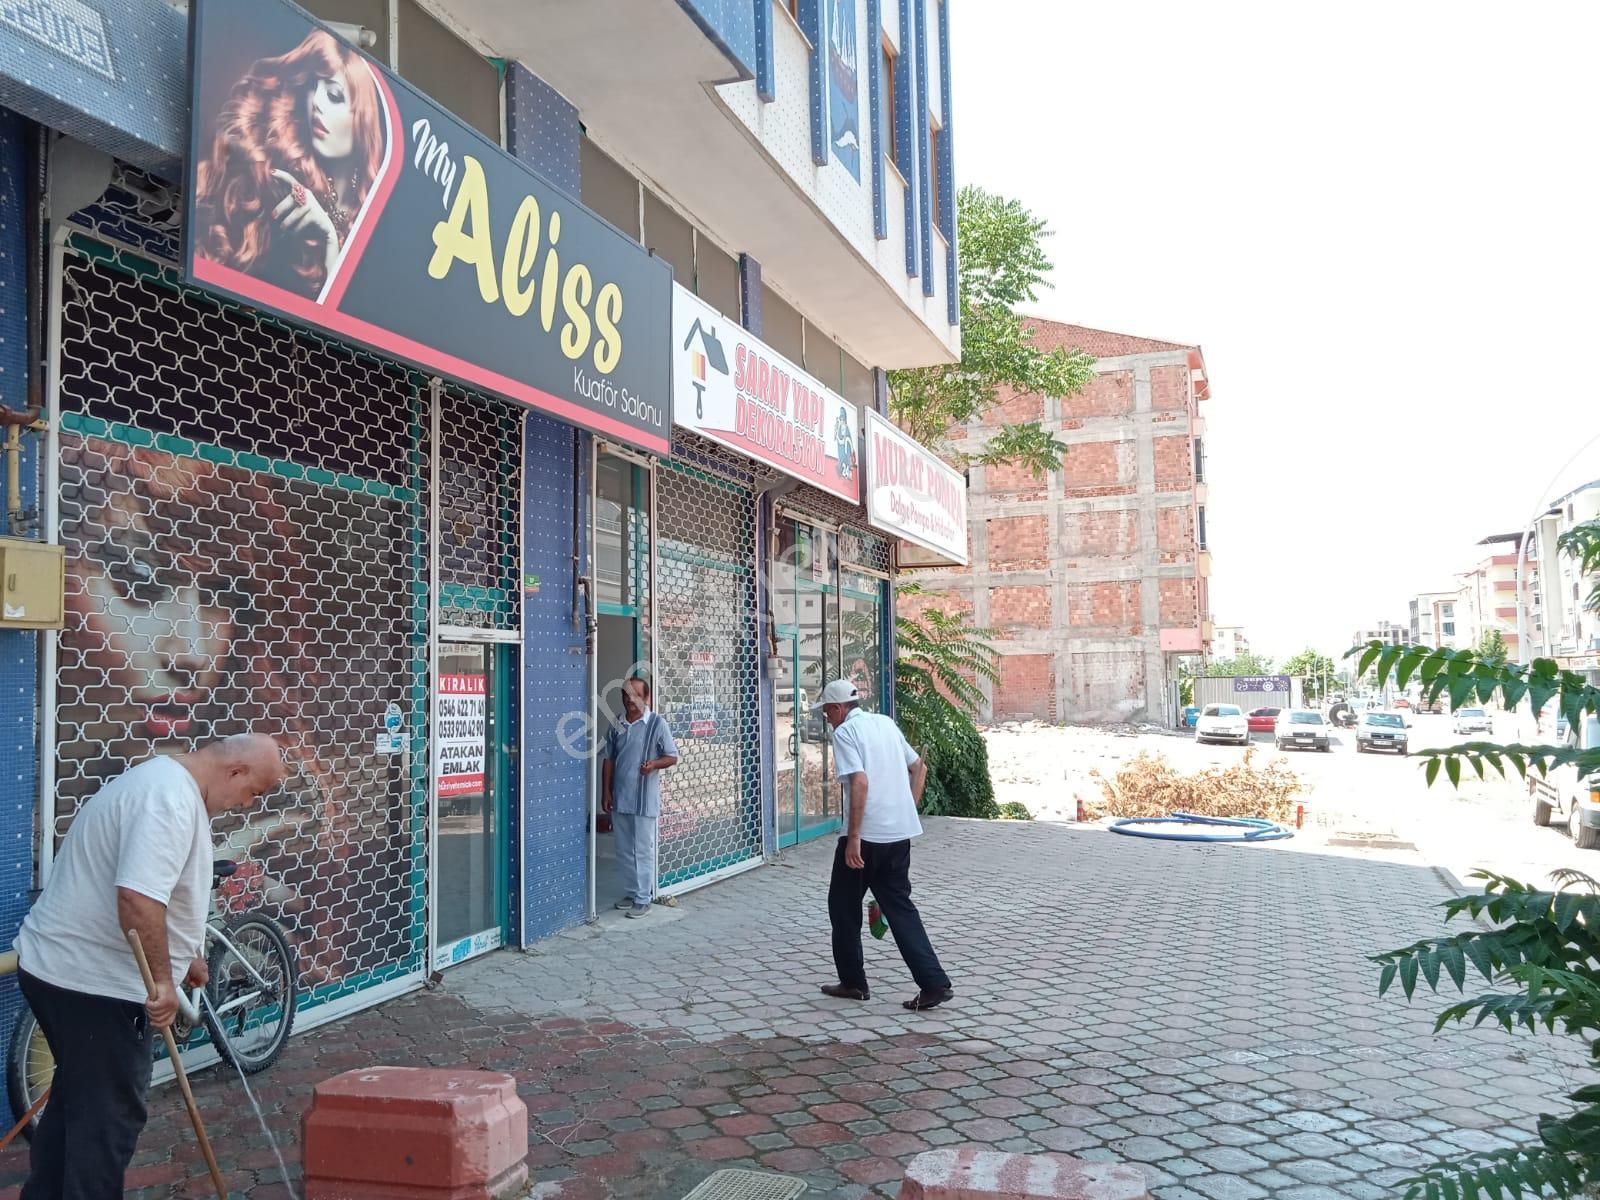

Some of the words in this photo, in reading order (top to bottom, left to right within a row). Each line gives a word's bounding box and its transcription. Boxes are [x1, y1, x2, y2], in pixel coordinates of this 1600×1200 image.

[427, 154, 623, 374] Aliss
[573, 366, 619, 406] Kuaför
[734, 342, 791, 416] SARAY
[792, 376, 826, 438] YAPI
[620, 387, 662, 428] Salonu
[735, 394, 826, 476] DEKORASYON
[873, 431, 924, 493] MURAT
[439, 677, 485, 692] KİRALIK
[469, 698, 477, 717] 71
[438, 719, 455, 739] 0533
[455, 719, 467, 738] 920
[467, 719, 476, 738] 42
[476, 719, 484, 737] 90
[440, 746, 483, 760] ATAKAN
[442, 760, 480, 775] EMLAK
